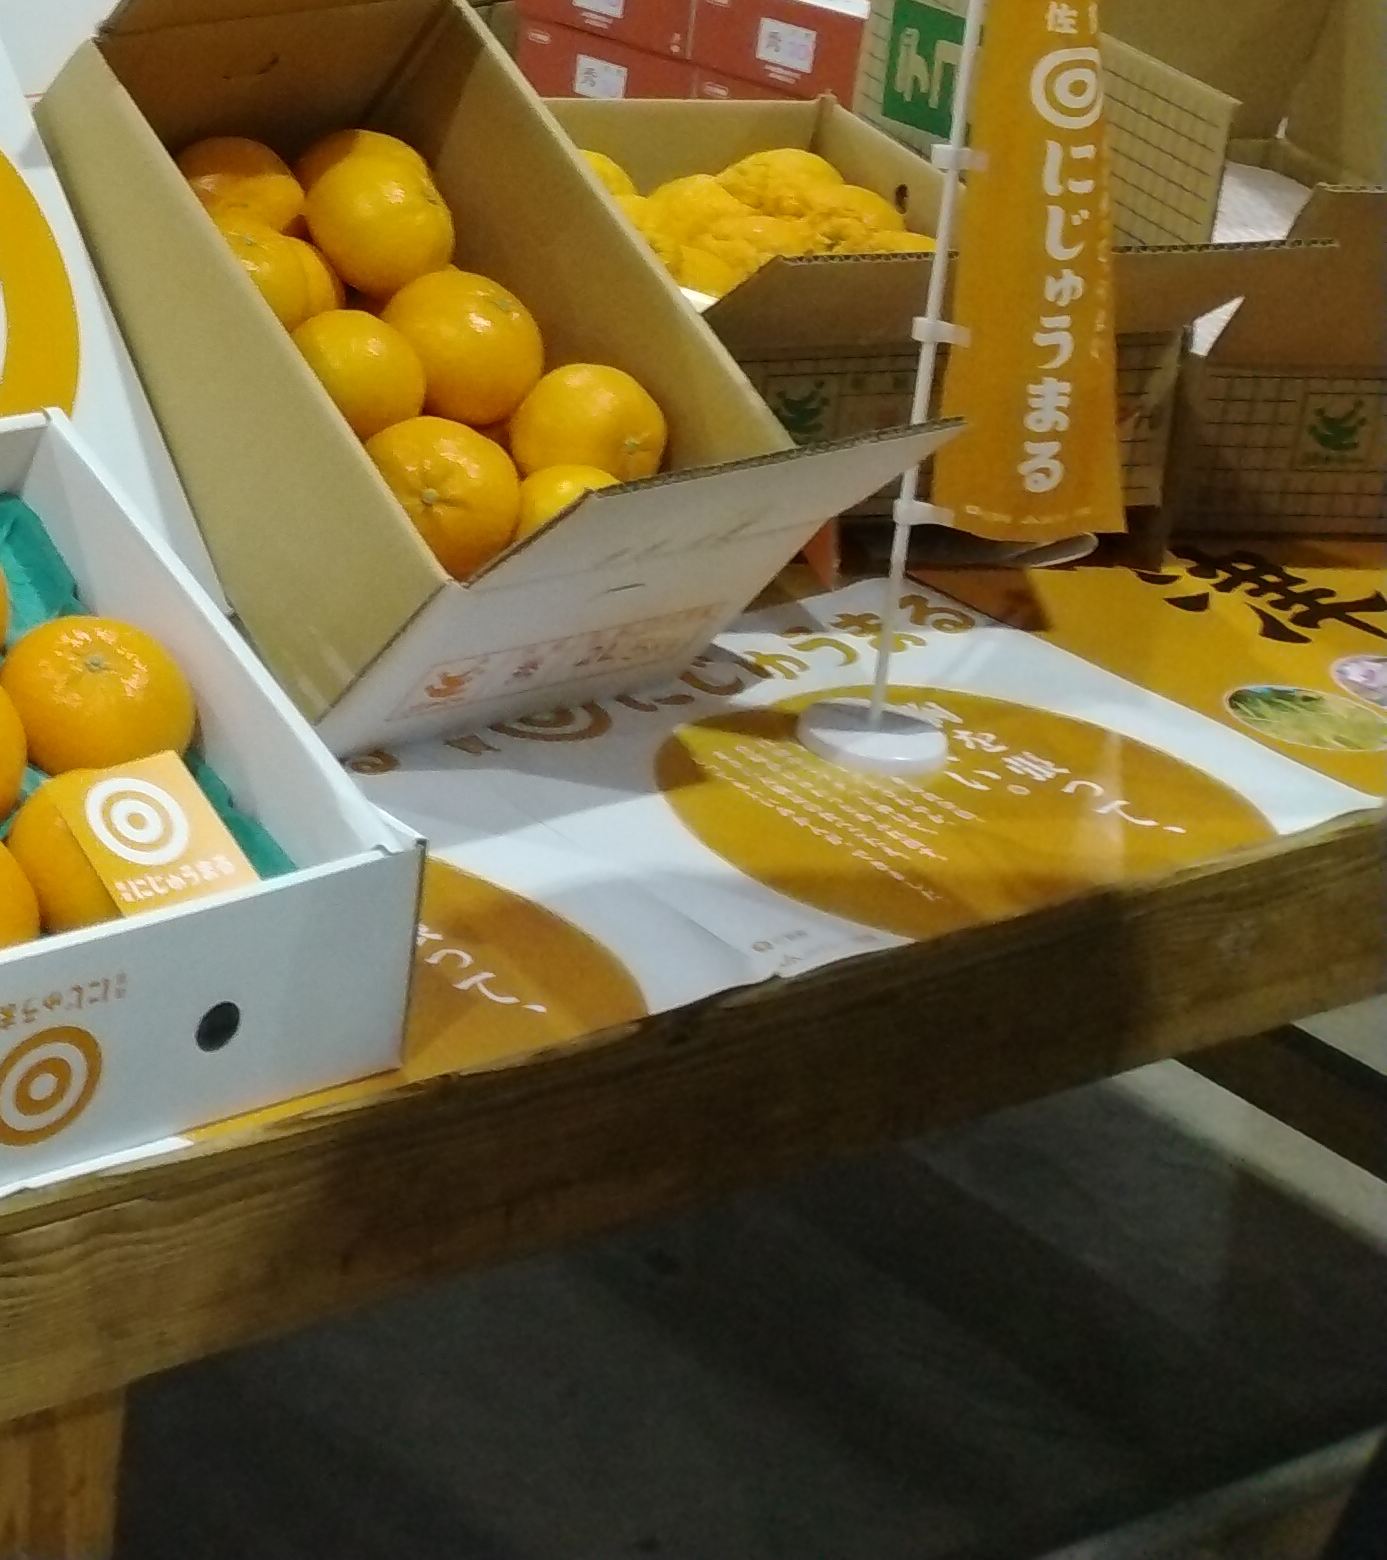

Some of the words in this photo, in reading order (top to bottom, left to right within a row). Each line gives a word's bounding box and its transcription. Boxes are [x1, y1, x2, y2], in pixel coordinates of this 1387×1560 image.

[1047, 2, 1097, 34] 佐
[1017, 140, 1097, 493] にじゅうまる
[134, 856, 236, 899] にじゅうまる
